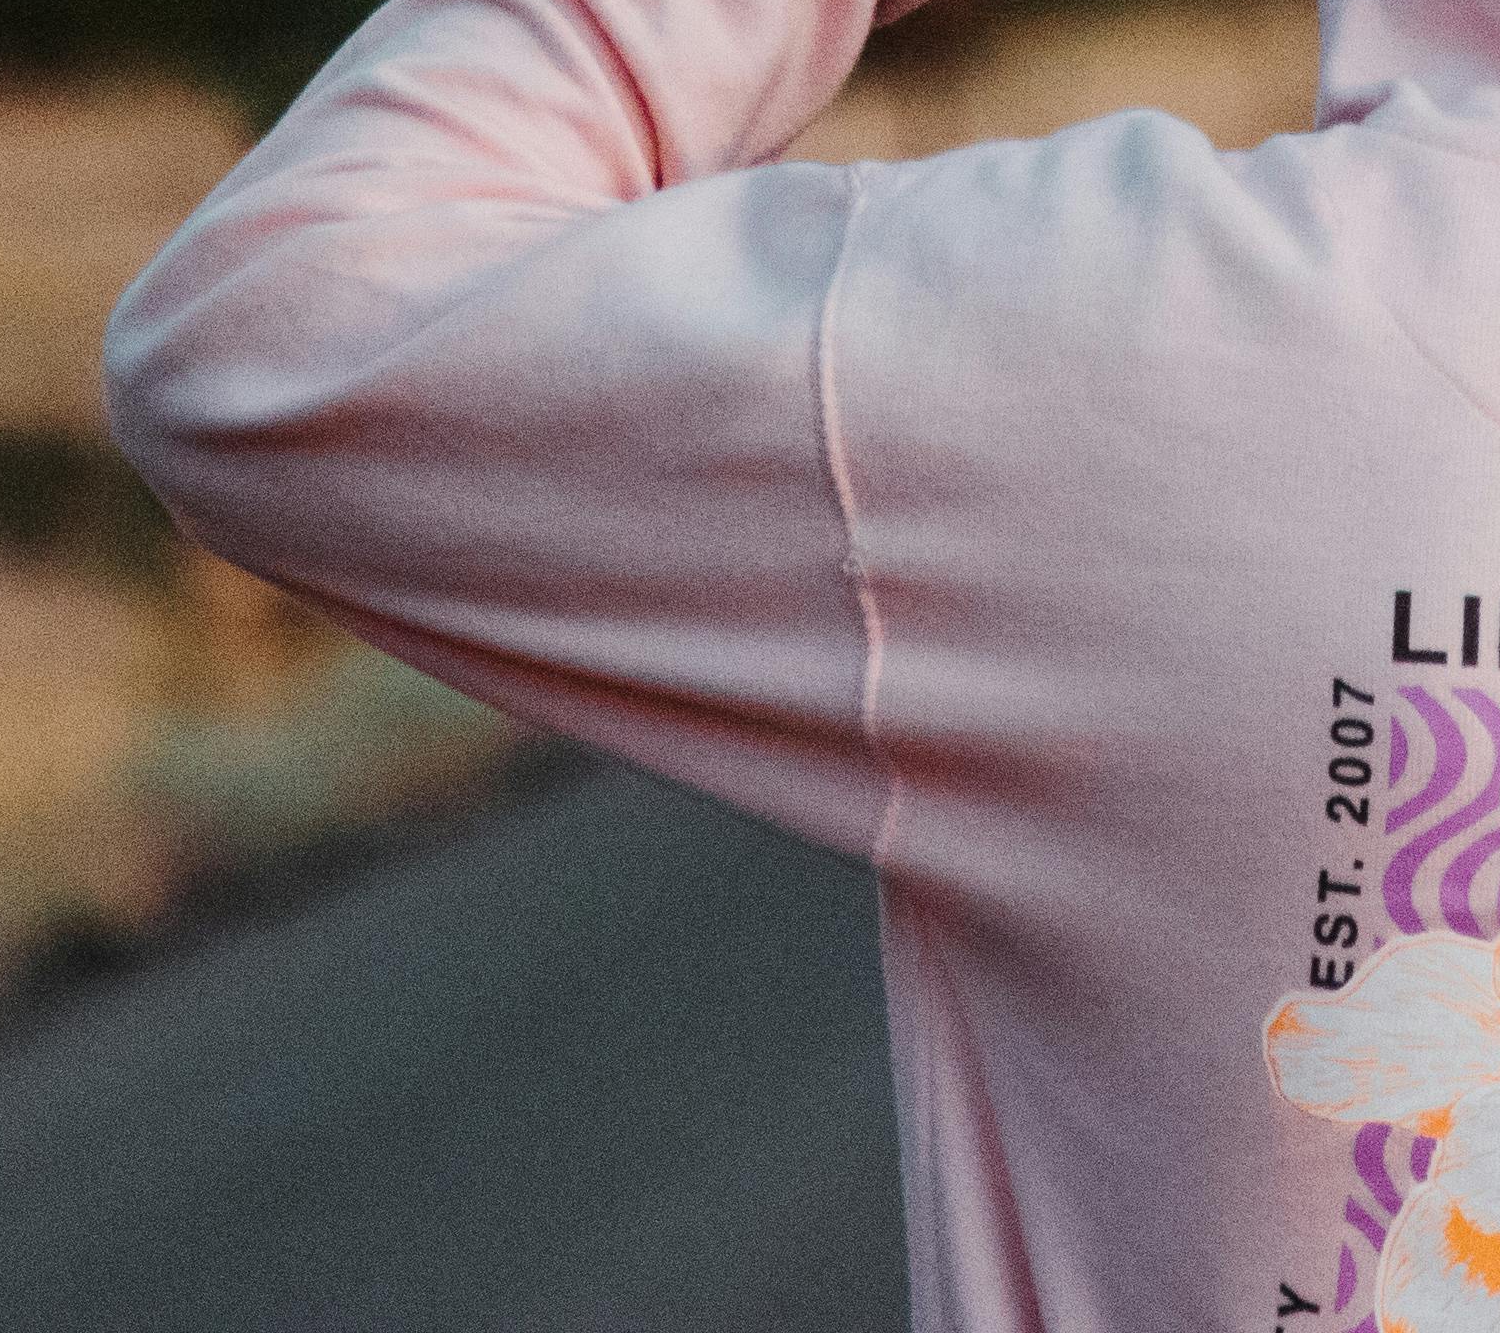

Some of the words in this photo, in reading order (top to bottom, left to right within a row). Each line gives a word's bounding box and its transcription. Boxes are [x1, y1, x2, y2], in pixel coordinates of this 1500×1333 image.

[1324, 676, 1375, 827] 2007
[1308, 858, 1365, 992] EST.
[1274, 1280, 1321, 1333] Y
